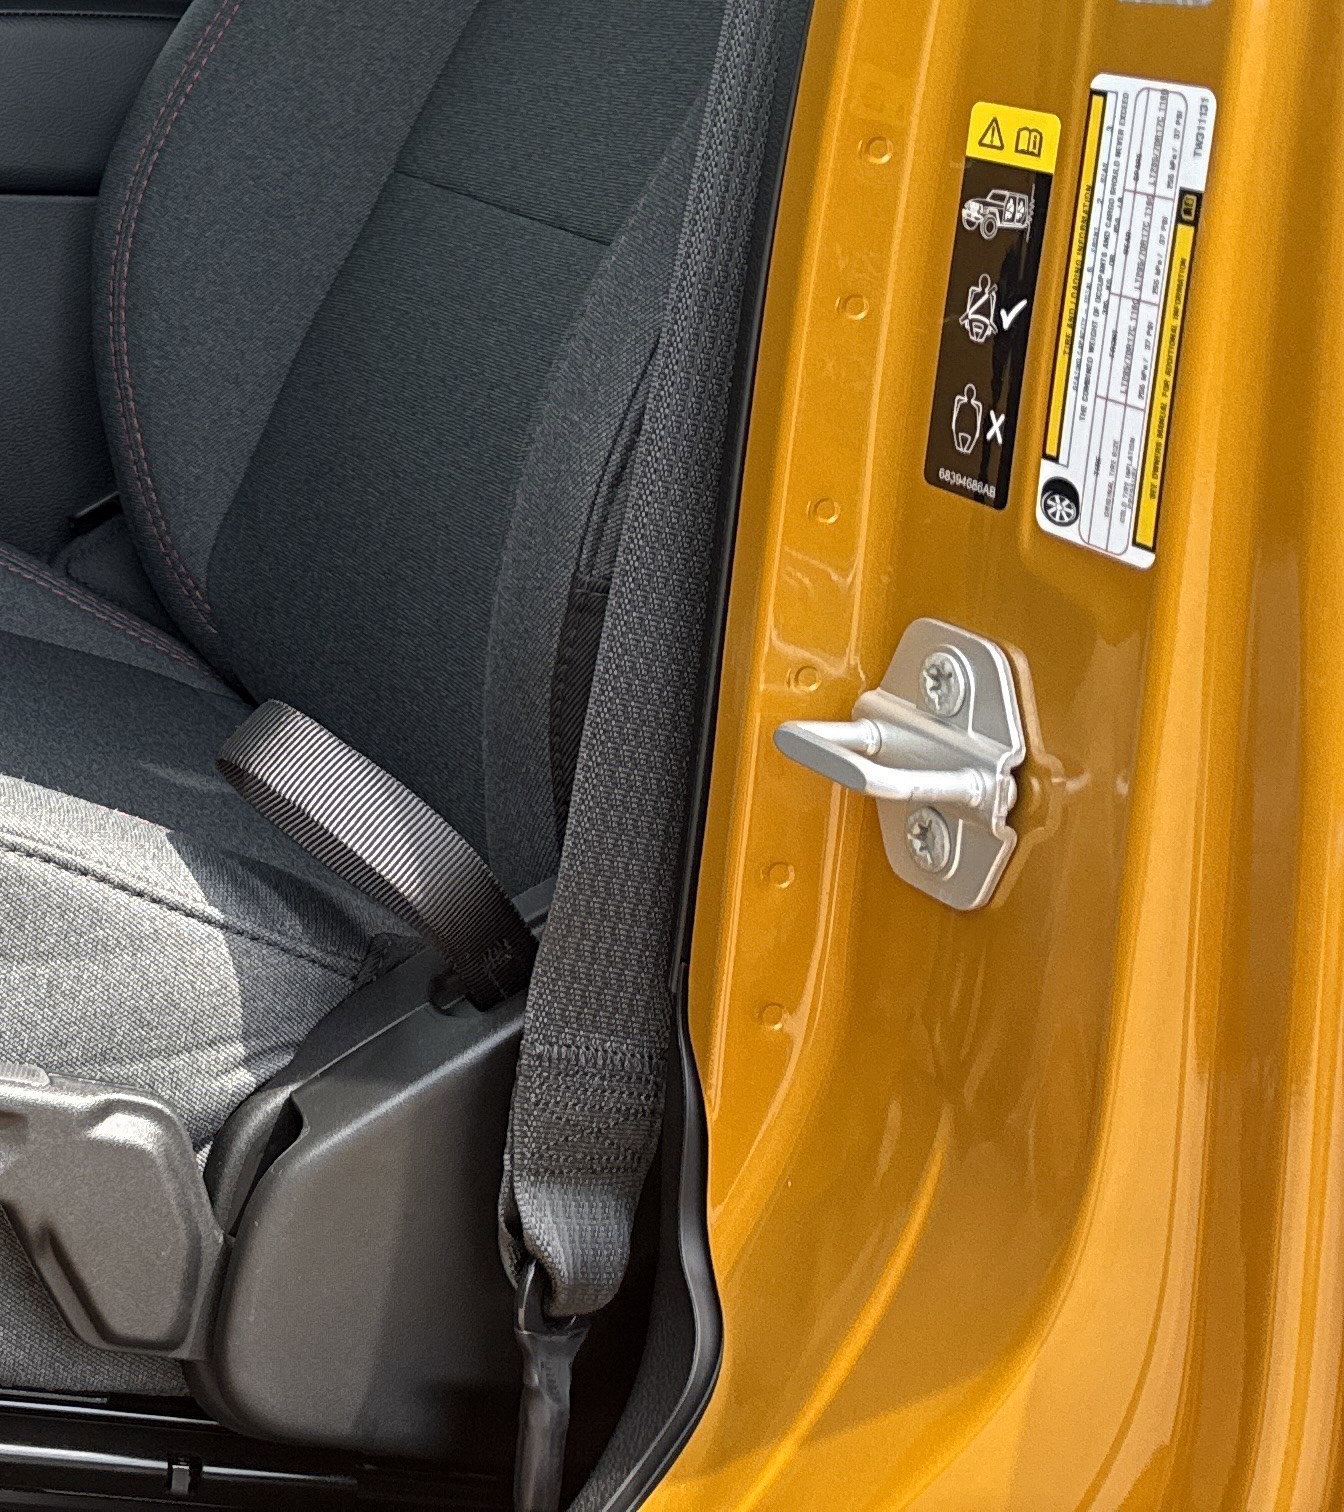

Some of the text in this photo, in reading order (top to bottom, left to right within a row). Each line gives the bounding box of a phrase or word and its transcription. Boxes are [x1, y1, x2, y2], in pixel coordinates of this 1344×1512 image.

[1063, 332, 1071, 356] TIRE
[1067, 307, 1075, 328] AND
[1077, 184, 1091, 255] INFORMATION
[1079, 92, 1129, 422] THE COMBINED WEIGHT OF OCCUPANTS AND CARGO SHOULD NEVER EXCEED
[1172, 257, 1186, 319] INFORMATION
